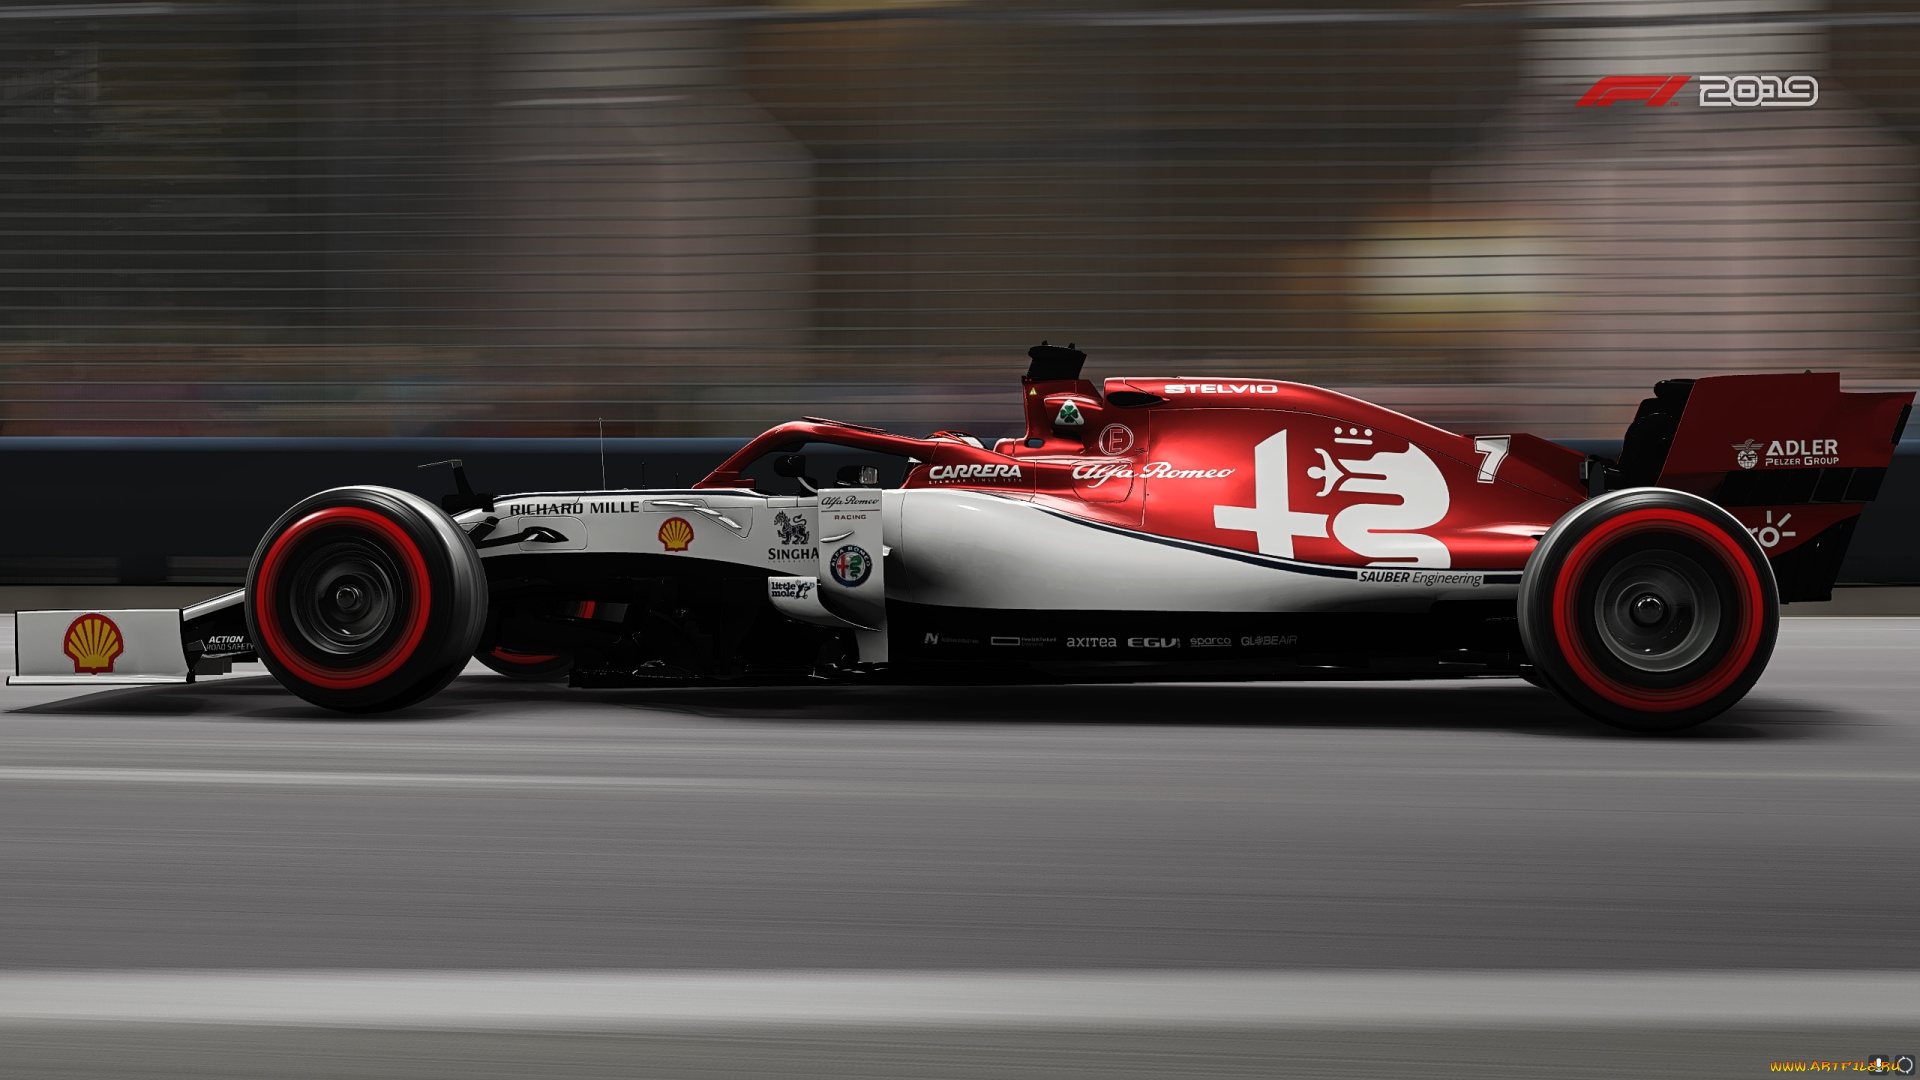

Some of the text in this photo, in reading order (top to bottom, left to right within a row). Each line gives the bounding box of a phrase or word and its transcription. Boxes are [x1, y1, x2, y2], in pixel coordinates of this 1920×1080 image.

[1164, 384, 1278, 394] STELVIO
[1766, 439, 1838, 456] ADLER
[1474, 435, 1511, 484] 7
[929, 464, 1022, 479] CARRERA
[1072, 461, 1236, 488] Alfa Romeo
[510, 501, 639, 516] RICHARD MILLE
[821, 495, 879, 509] Alfa Romeo
[768, 548, 819, 560] SINGHA
[771, 582, 796, 590] little
[1359, 571, 1482, 587] SAUBER Engineering
[208, 636, 244, 644] ACTION
[1190, 637, 1231, 647] sparco
